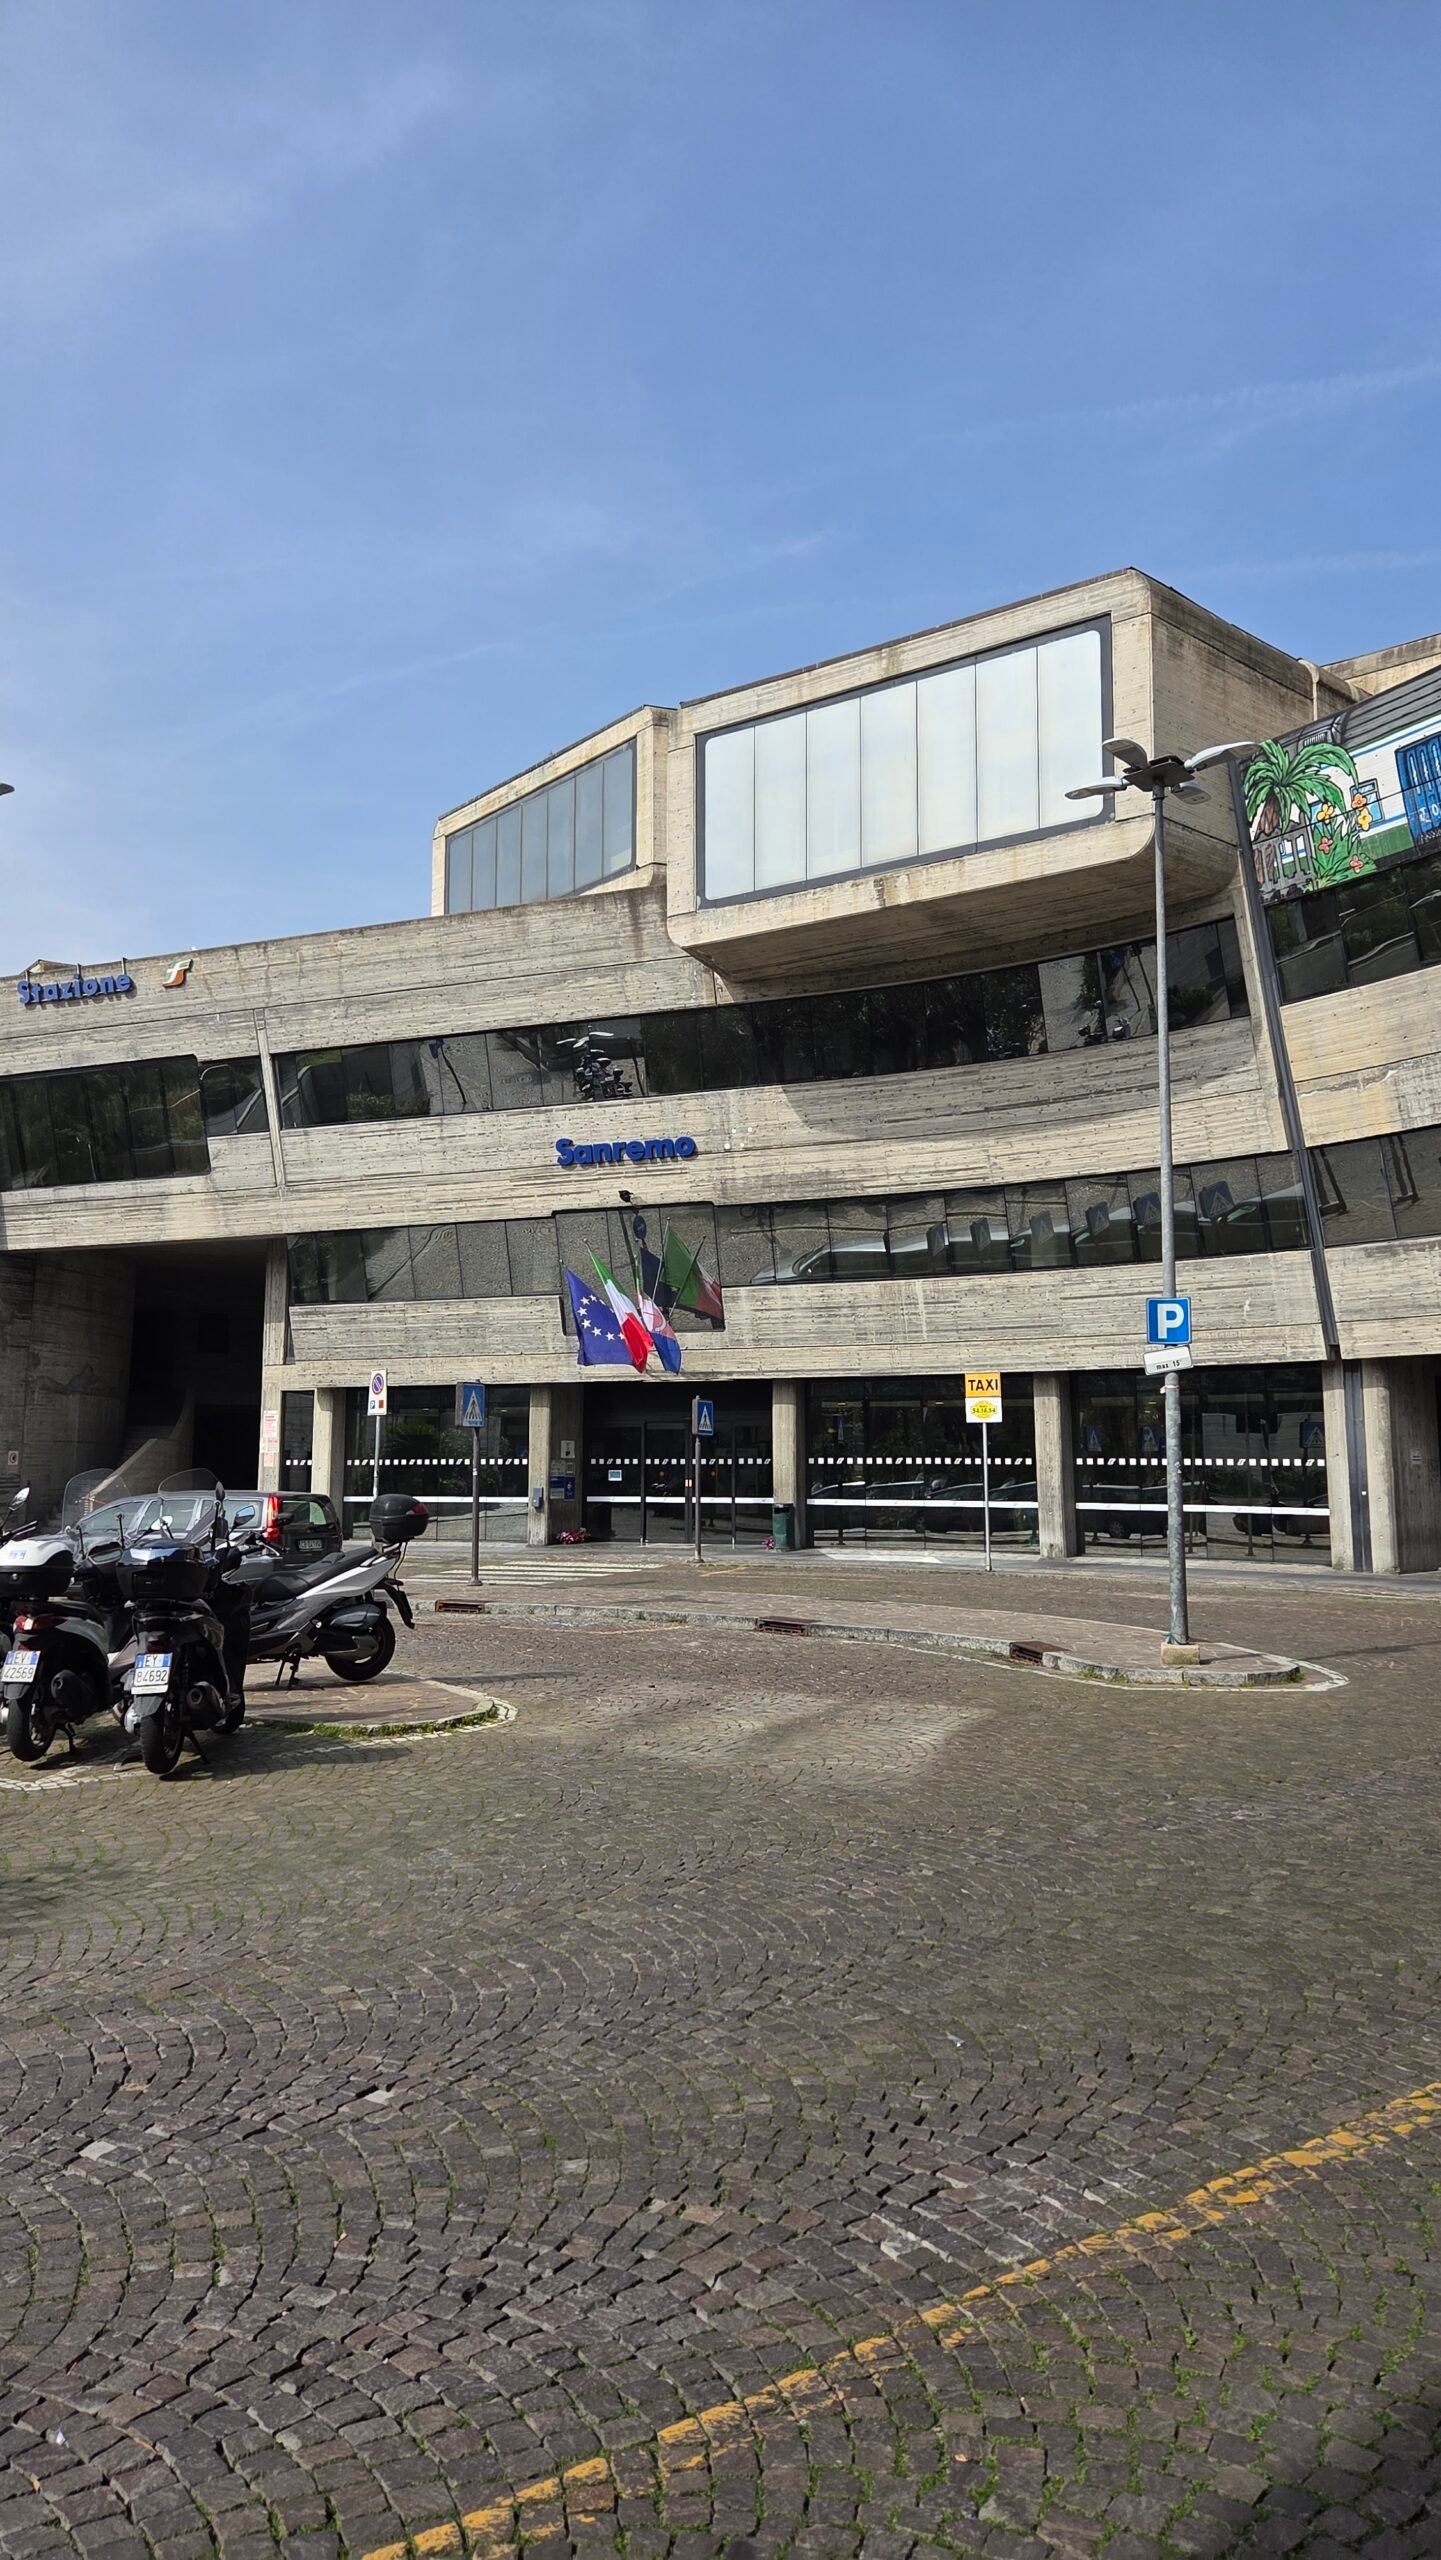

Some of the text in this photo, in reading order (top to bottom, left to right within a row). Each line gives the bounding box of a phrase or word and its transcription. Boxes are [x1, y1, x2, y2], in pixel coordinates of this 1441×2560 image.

[16, 973, 132, 1005] Stazione
[556, 1136, 697, 1166] Sanremo
[1157, 1303, 1185, 1339] P
[968, 1378, 999, 1391] TAXI
[145, 1655, 158, 1667] EY
[4, 1667, 34, 1679] 42569
[136, 1669, 168, 1683] 84692
